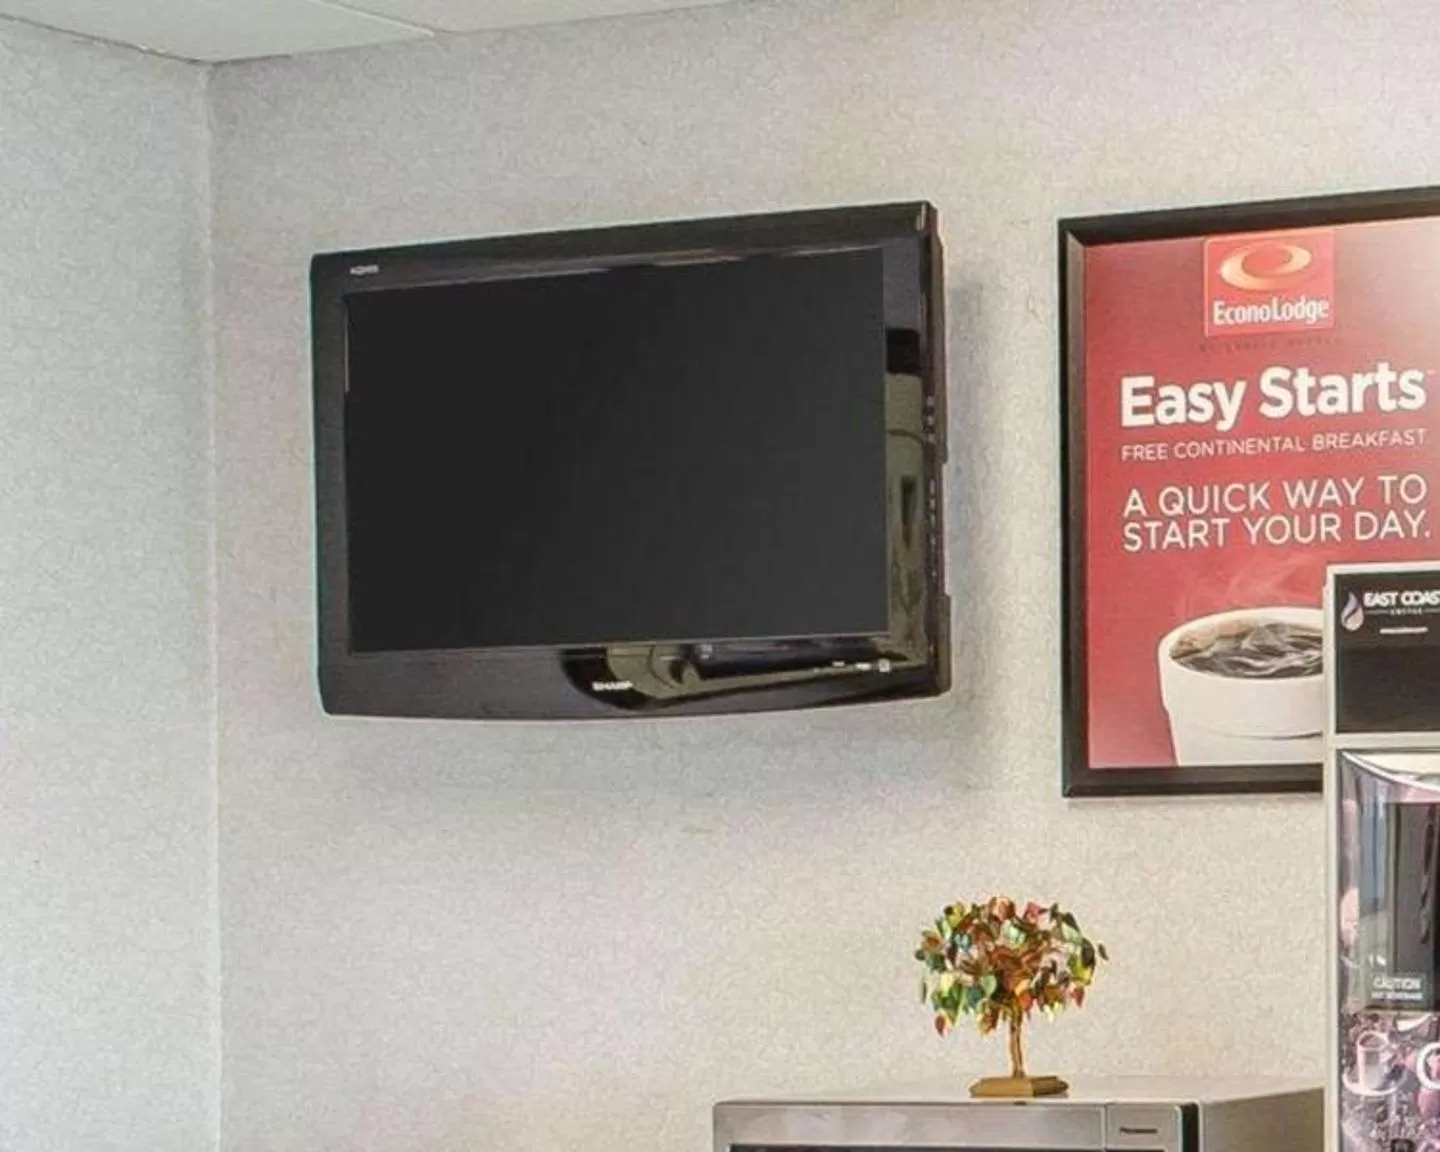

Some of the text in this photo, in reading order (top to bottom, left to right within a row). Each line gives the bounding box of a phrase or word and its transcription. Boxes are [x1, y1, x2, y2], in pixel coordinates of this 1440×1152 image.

[1212, 295, 1330, 325] EconoLodge
[1121, 363, 1427, 431] Easy Starts
[1121, 428, 1427, 461] FREE CONTINENTAL BREAKFAST
[1122, 474, 1428, 517] A QUICK WAY TO
[1123, 510, 1432, 552] START YOUR DAY.
[1363, 591, 1399, 608] EAST
